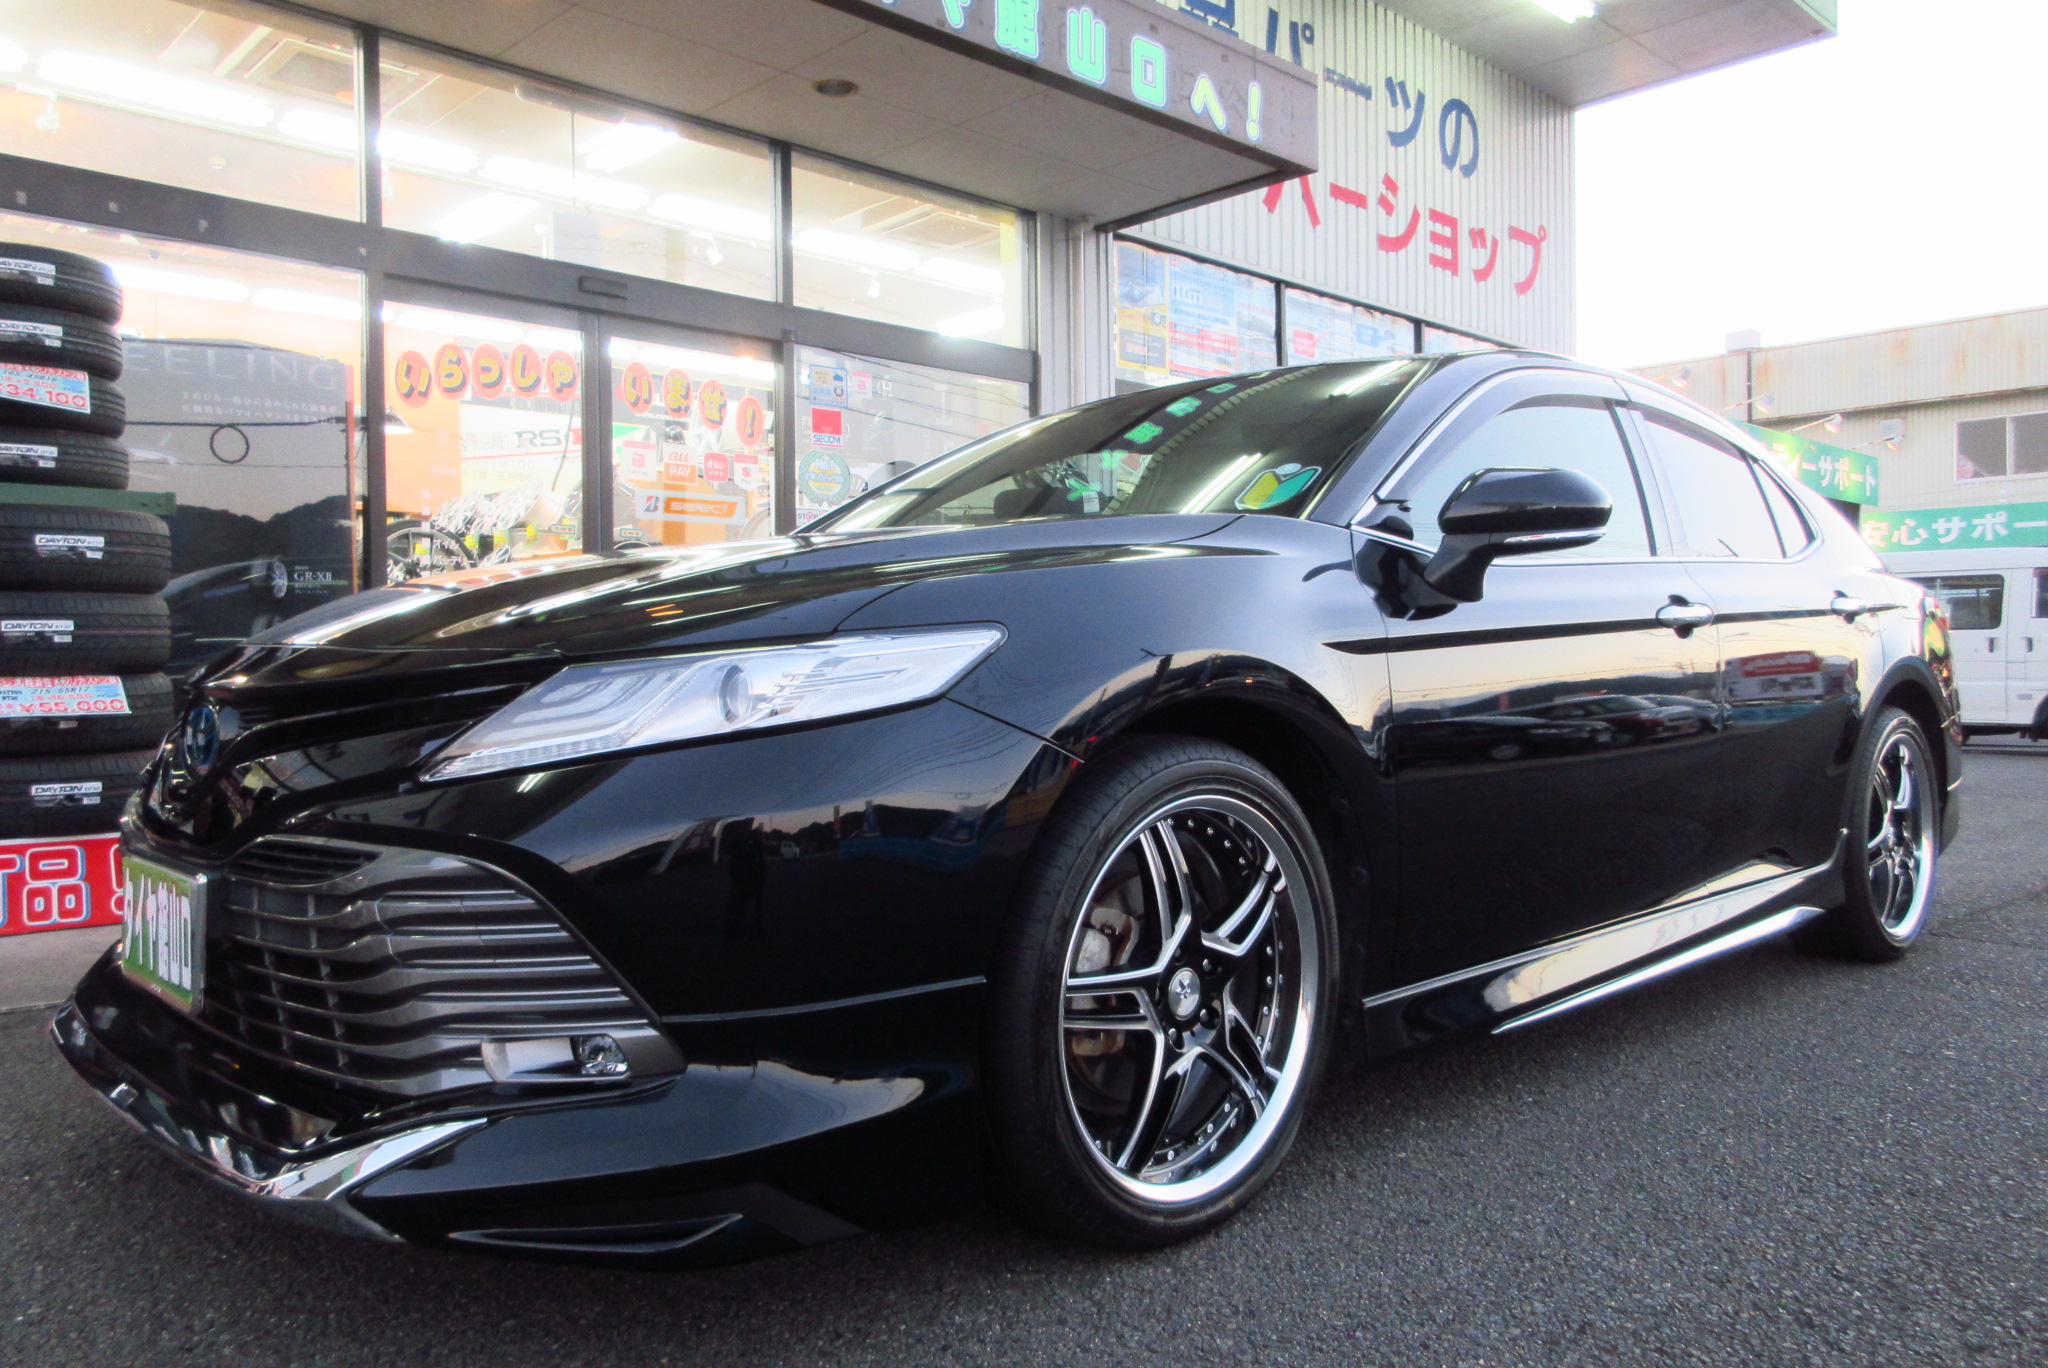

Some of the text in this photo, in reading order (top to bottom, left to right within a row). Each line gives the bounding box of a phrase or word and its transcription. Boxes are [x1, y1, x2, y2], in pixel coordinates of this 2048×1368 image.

[880, 0, 1263, 140] 館山口へ!
[813, 434, 841, 445] SECOM
[669, 451, 691, 462] au
[669, 465, 691, 477] PAY
[806, 472, 845, 483] RAYS
[38, 537, 87, 545] DAYTON
[4, 622, 54, 630] DAYTON
[34, 785, 83, 794] DAYTON
